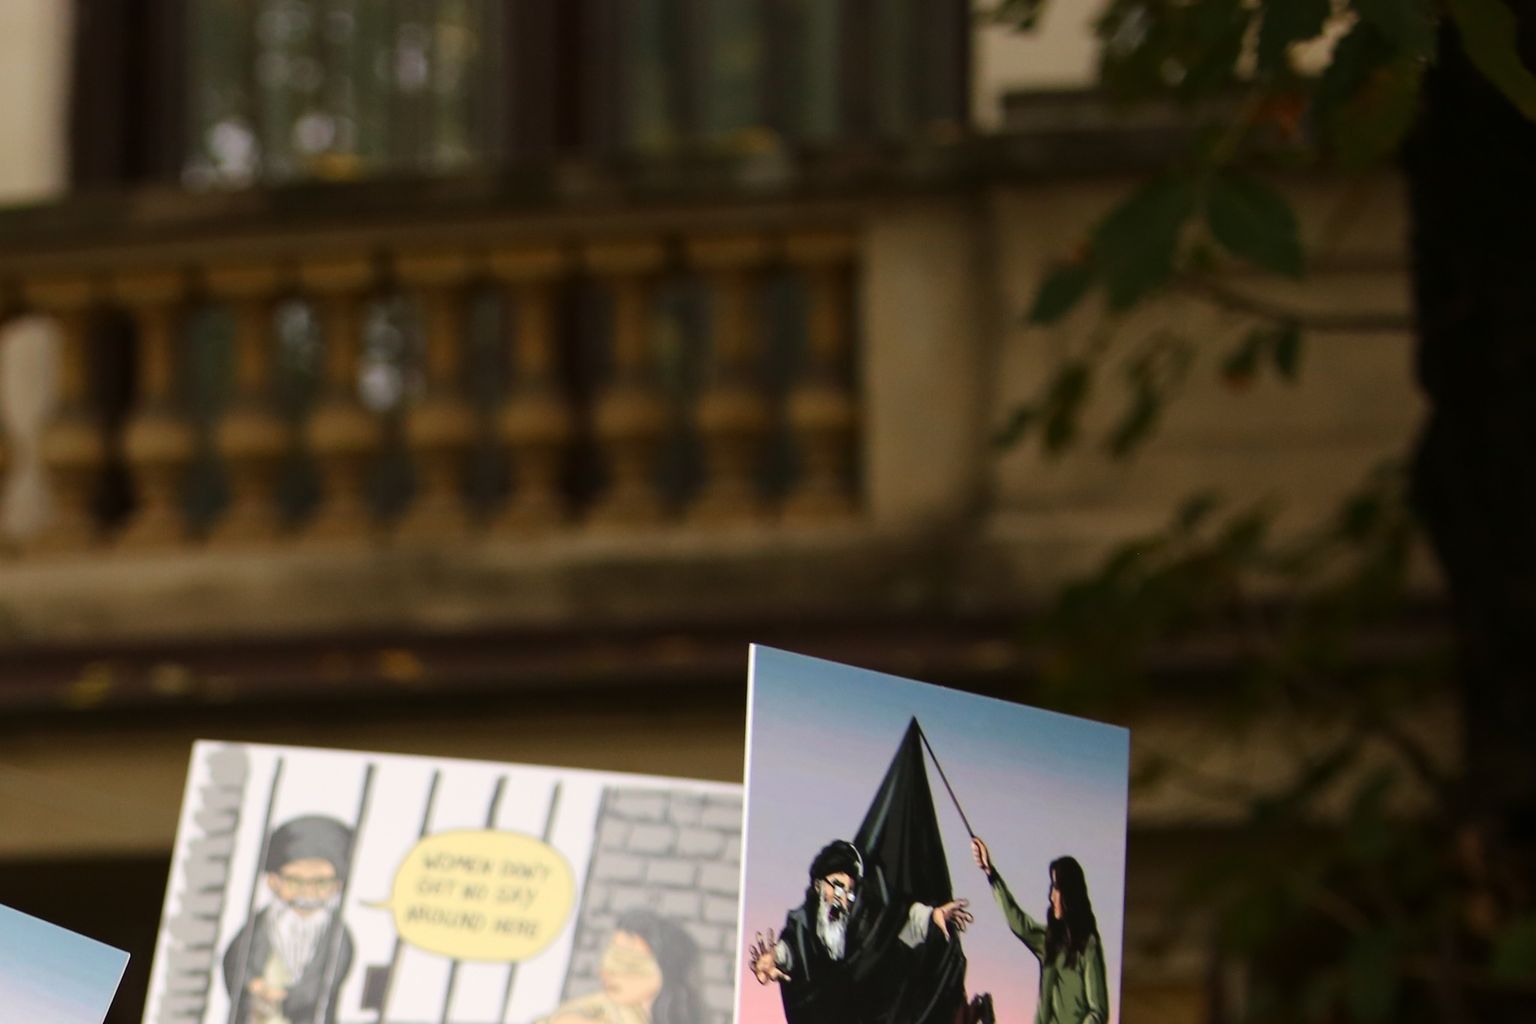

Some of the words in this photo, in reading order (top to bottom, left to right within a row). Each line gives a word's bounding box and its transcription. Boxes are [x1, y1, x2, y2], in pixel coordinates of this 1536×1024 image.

[422, 852, 492, 874] WOMEN
[463, 883, 488, 900] NO
[406, 904, 486, 932] AROUND
[495, 918, 538, 940] HERE
